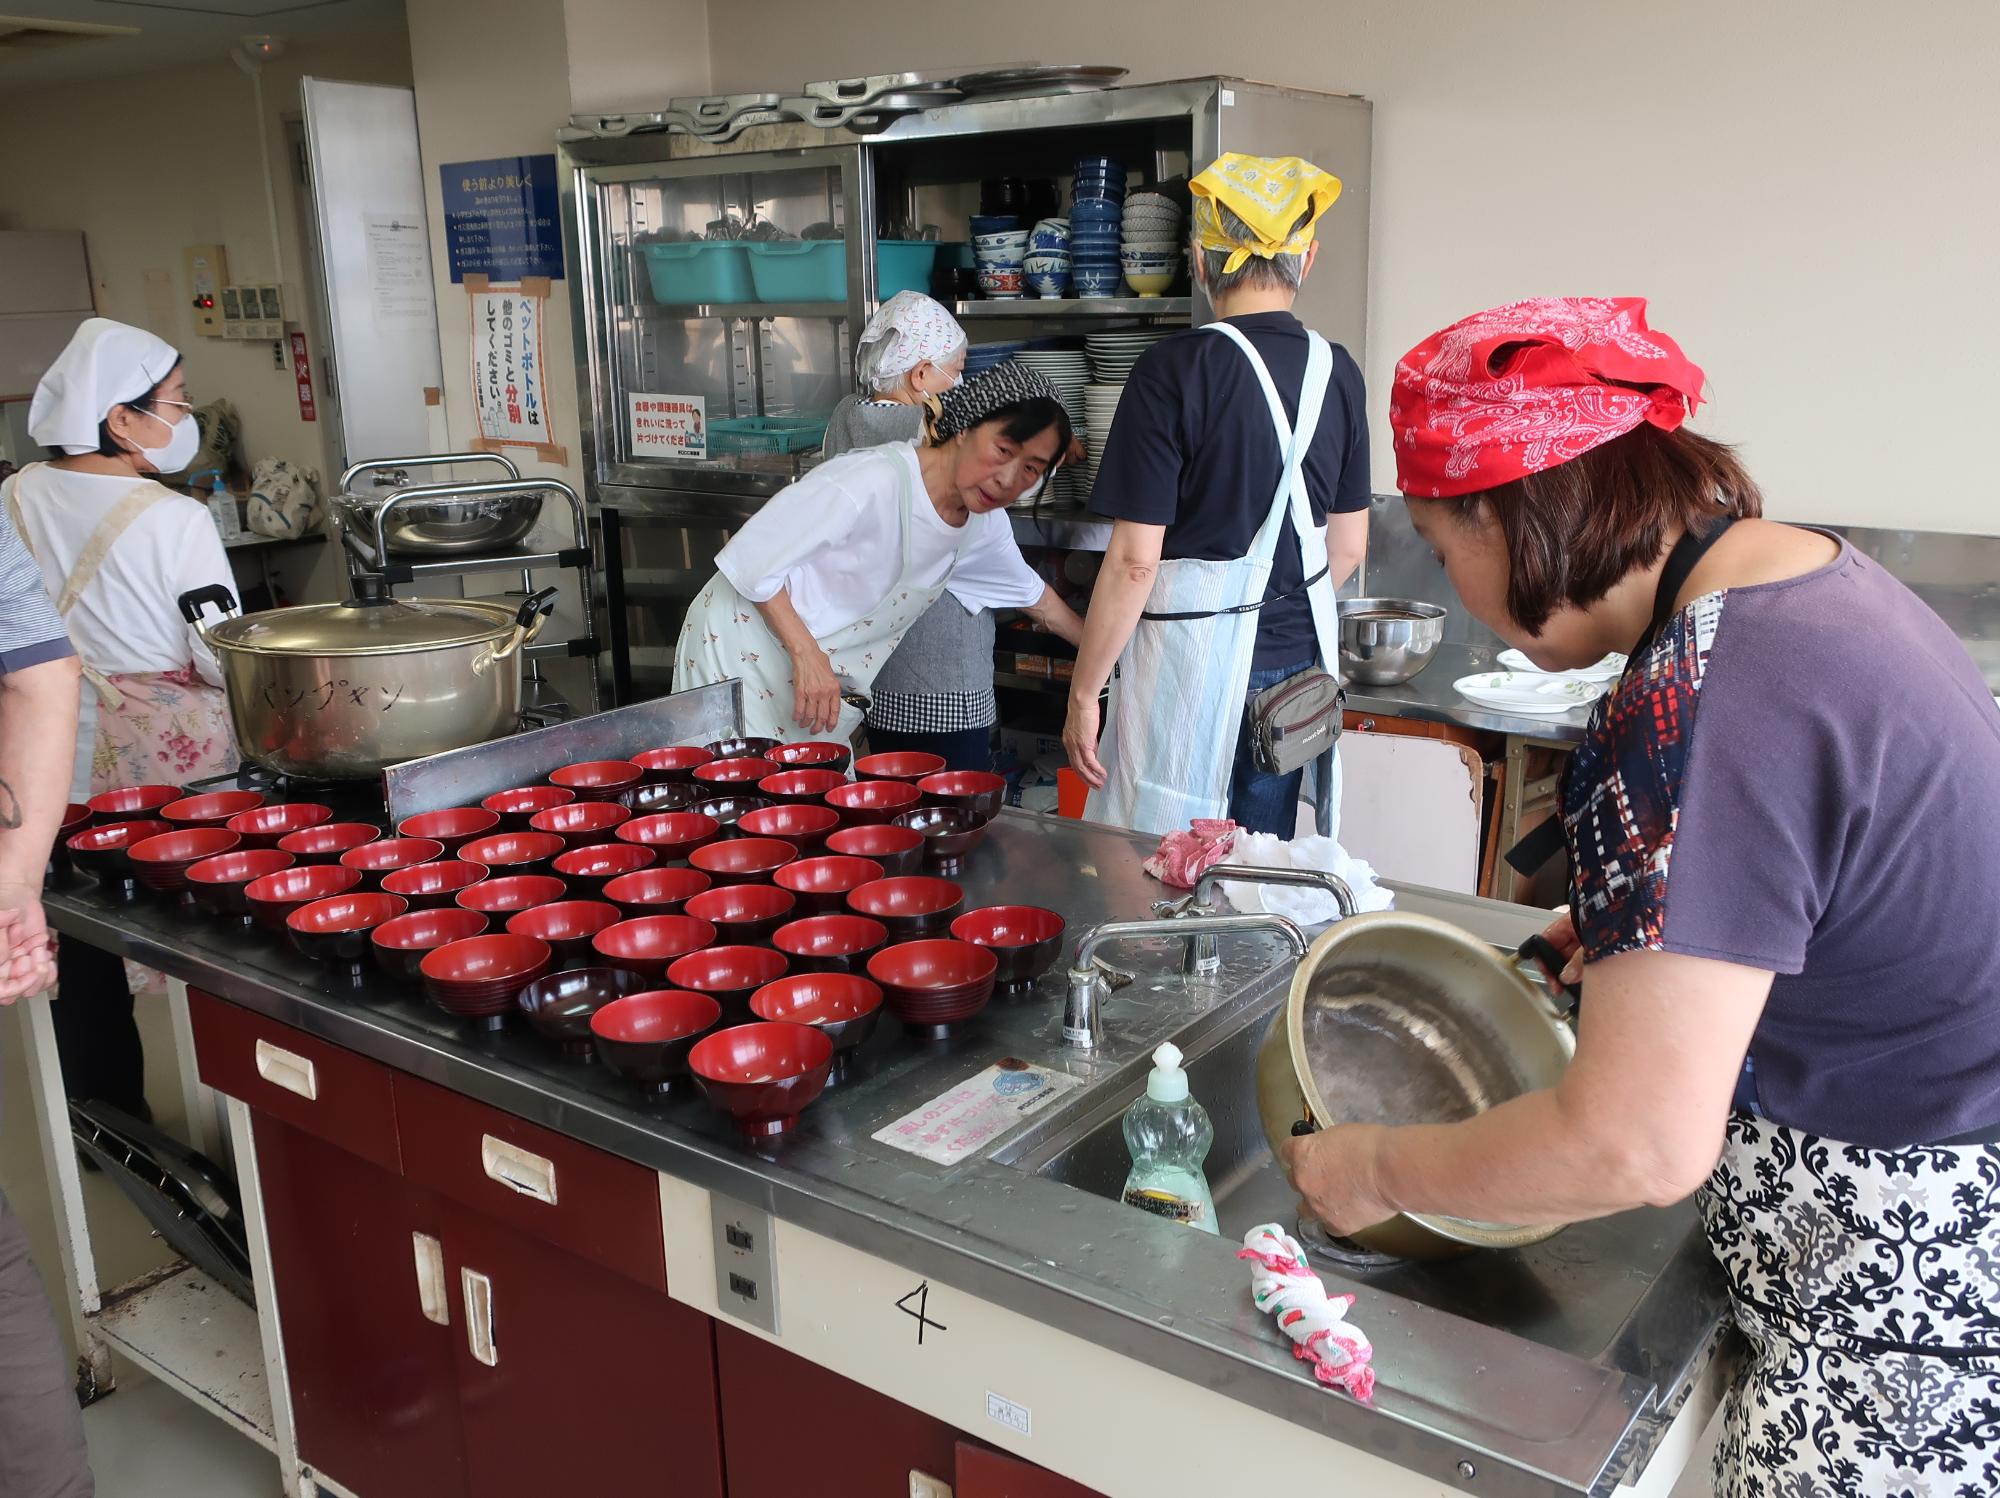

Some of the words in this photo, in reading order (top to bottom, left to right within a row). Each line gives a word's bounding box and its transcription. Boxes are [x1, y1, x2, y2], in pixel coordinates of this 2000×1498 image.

[462, 174, 532, 192] 使う前より美しく
[486, 299, 502, 408] してください。
[502, 299, 522, 424] 他のゴミと分別
[519, 299, 539, 425] ペットボトルは
[635, 401, 693, 413] 食器や調理器具は
[636, 418, 686, 429] きれいに洗って
[895, 1279, 947, 1345] 4
